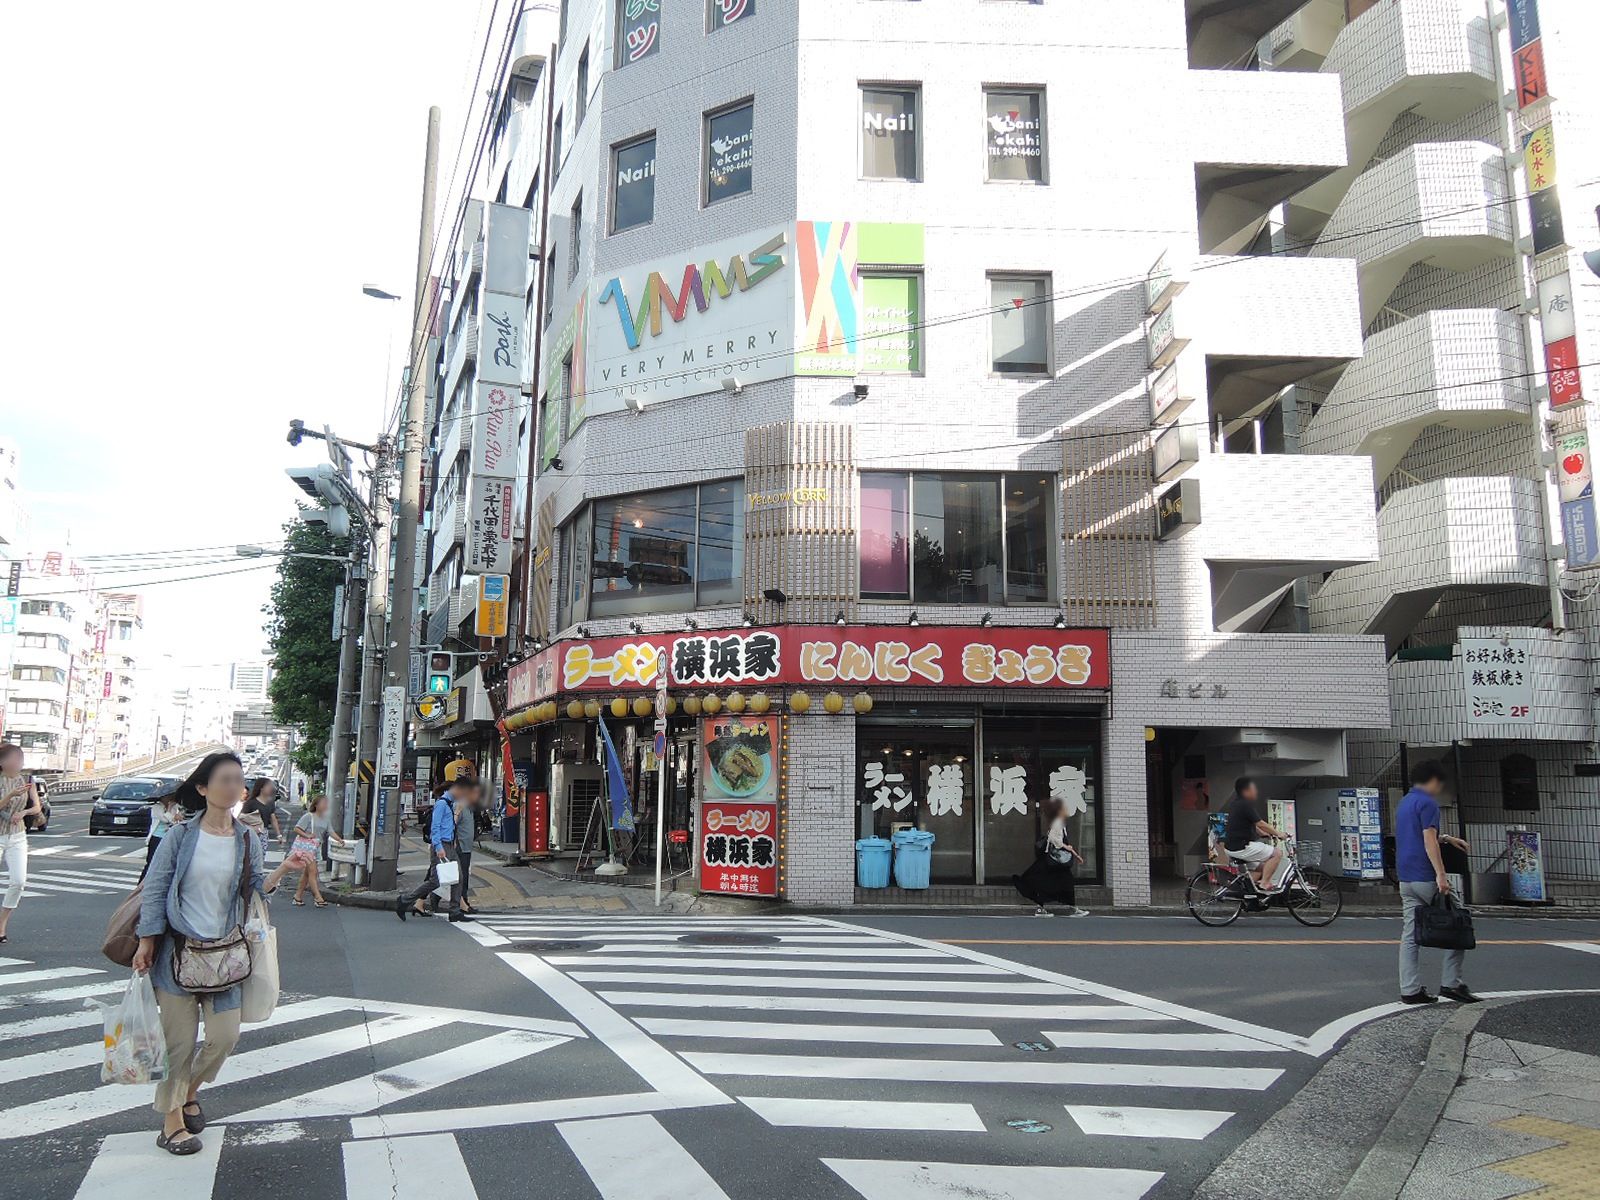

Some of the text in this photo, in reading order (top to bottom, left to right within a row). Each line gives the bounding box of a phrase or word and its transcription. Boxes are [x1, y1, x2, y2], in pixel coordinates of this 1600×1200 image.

[864, 112, 914, 130] Nail
[618, 159, 655, 186] Nail
[1530, 139, 1546, 187] 花水木
[602, 330, 777, 382] VERY MERRY
[614, 359, 761, 399] MUSIC SCHOOL
[564, 642, 660, 690] ラーメン
[672, 632, 781, 683] 横浜家
[801, 641, 1092, 685] にんにく ぎょうざ
[1466, 648, 1525, 664] お好み焼き
[1472, 669, 1523, 686] 鉄板焼き
[1510, 706, 1529, 717] 2F
[927, 763, 1087, 818] 横浜家
[707, 809, 771, 832] ラーメン
[704, 833, 775, 869] 横浜家
[720, 873, 759, 882] 年中無休
